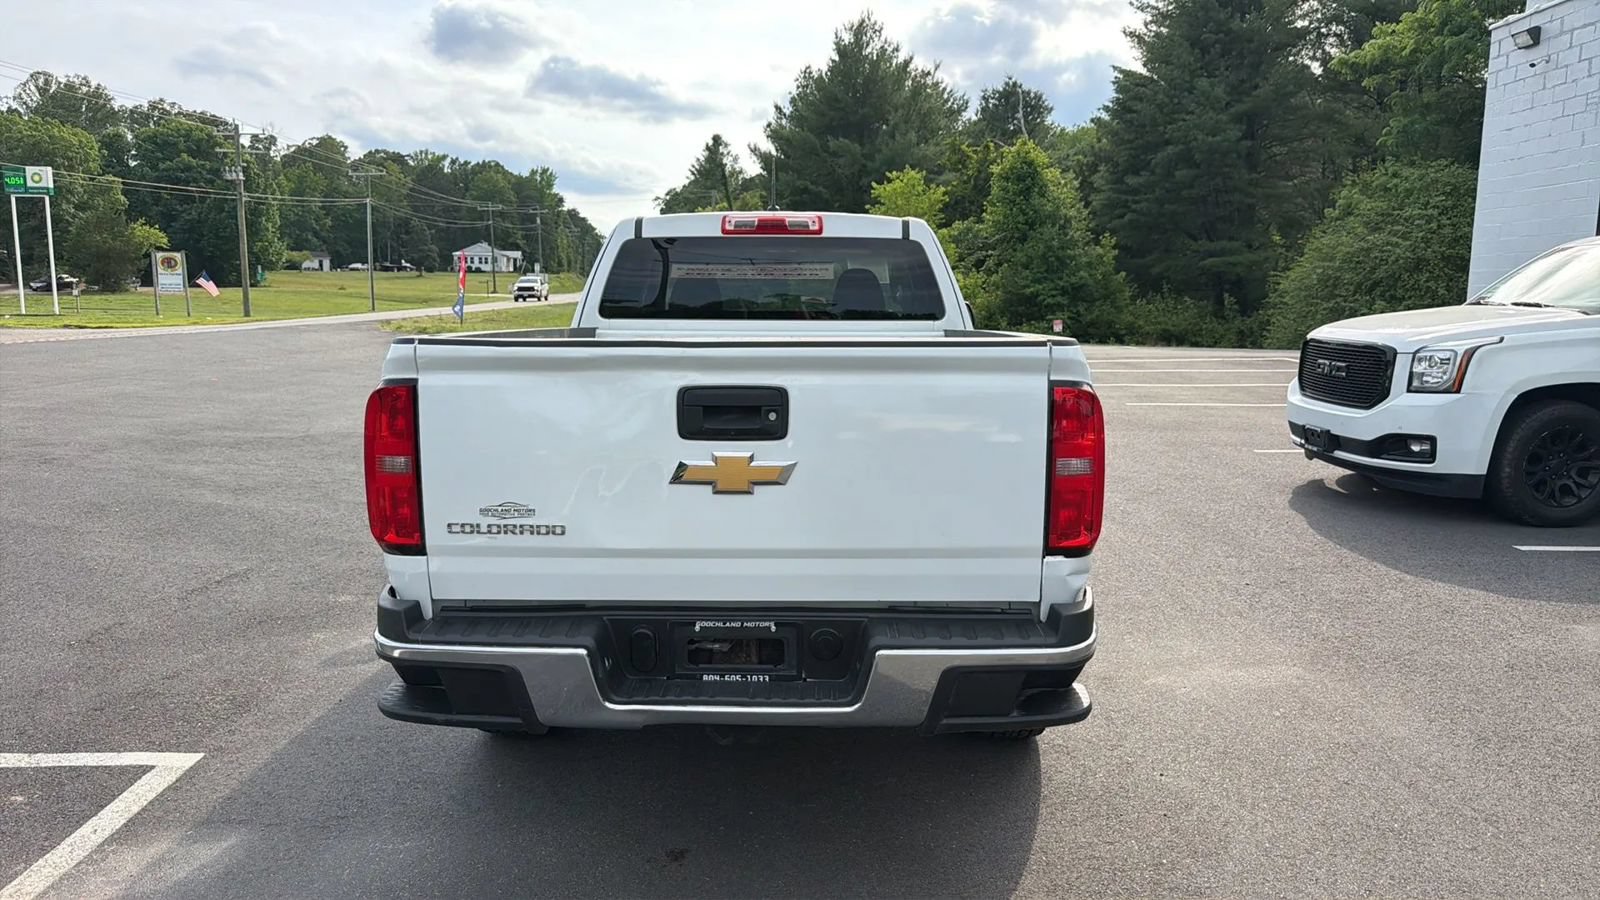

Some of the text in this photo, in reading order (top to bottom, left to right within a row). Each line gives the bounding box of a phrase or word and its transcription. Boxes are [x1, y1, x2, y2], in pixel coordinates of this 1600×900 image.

[1317, 359, 1347, 377] GMC
[447, 522, 566, 536] COLORADO
[702, 674, 769, 682] 804-605-1033
